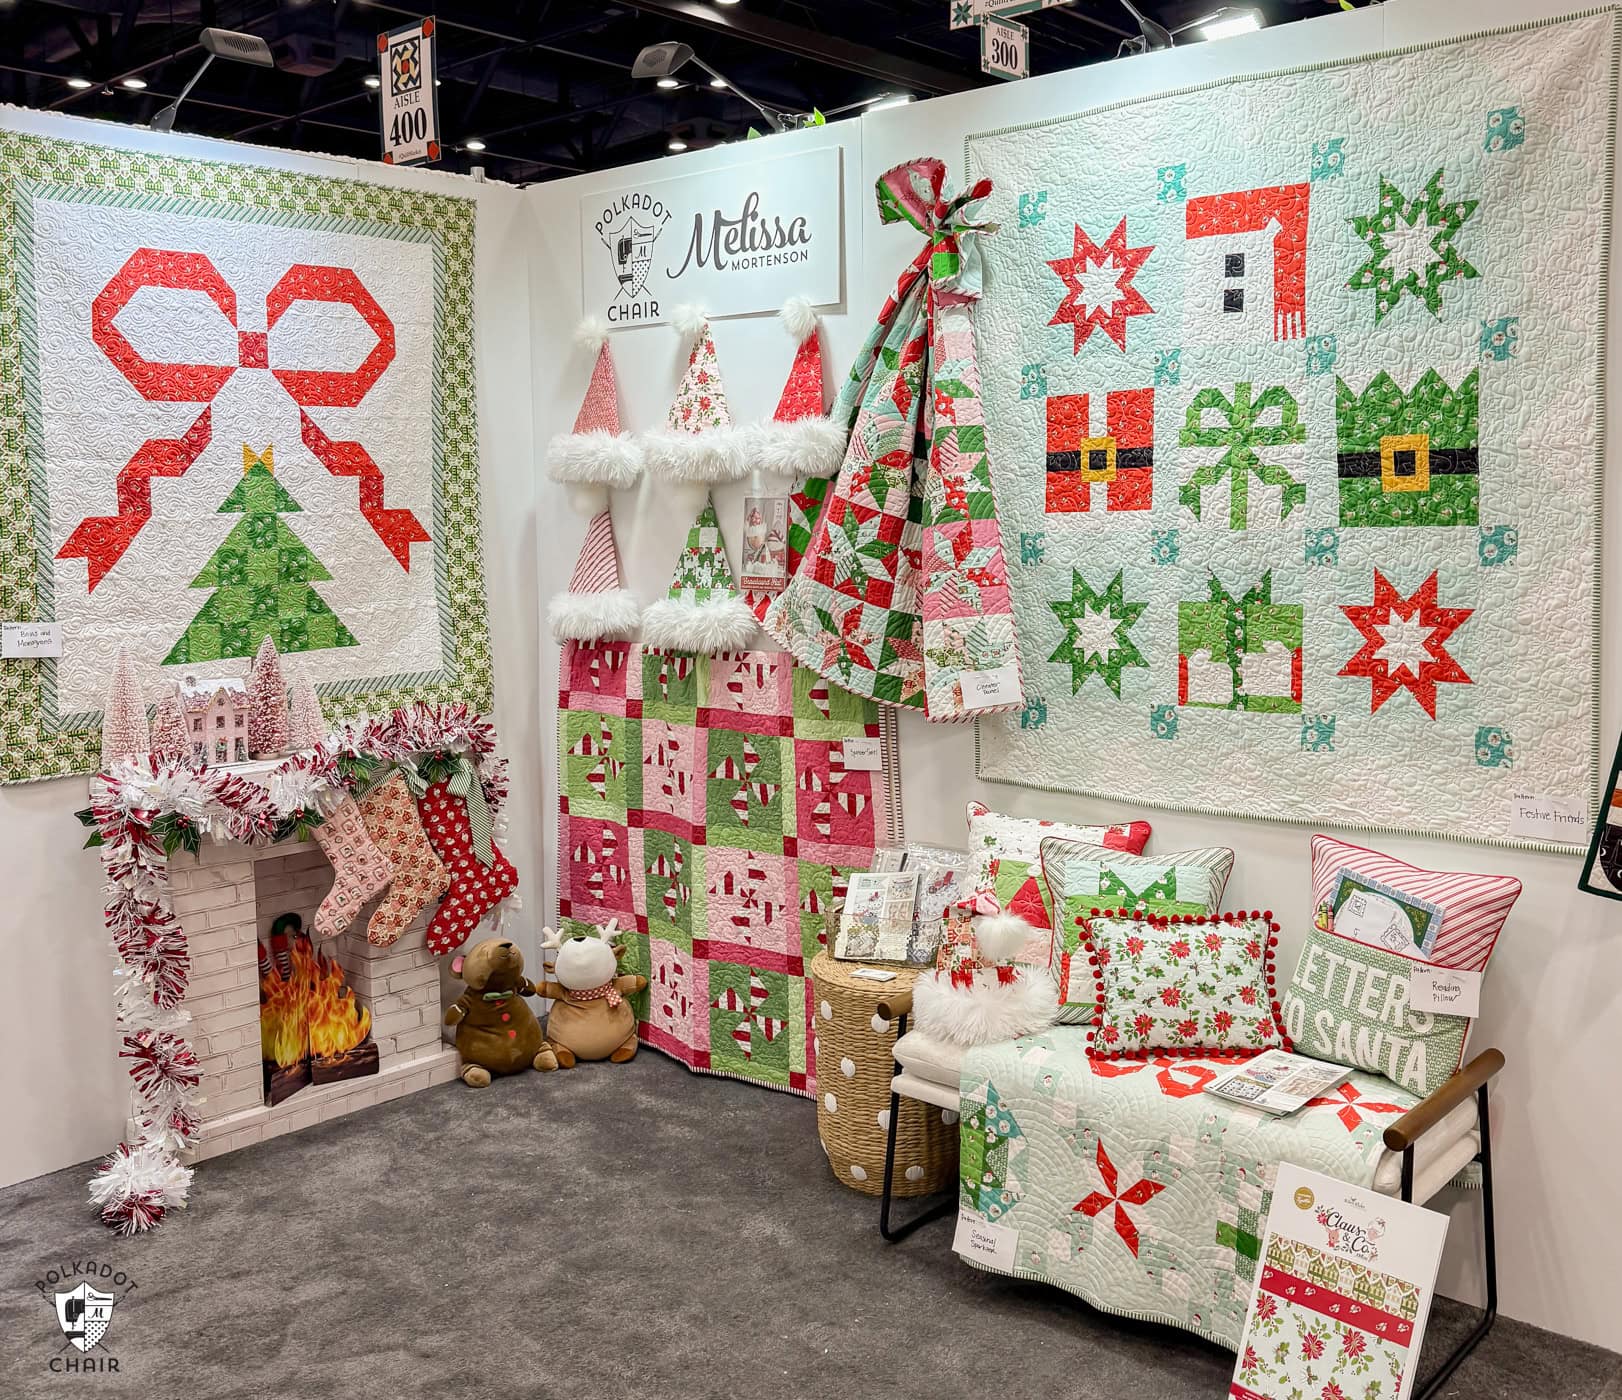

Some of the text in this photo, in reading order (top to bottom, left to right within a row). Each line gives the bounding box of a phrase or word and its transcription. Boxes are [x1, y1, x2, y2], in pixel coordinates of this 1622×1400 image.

[996, 26, 1015, 41] AISLE
[991, 38, 1018, 70] 300
[394, 91, 421, 110] AISLE
[390, 107, 427, 147] 400
[595, 193, 672, 235] POLKADOT
[666, 191, 812, 279] Melissa
[731, 249, 809, 272] MORTENSON
[607, 300, 660, 322] CHAIR
[1519, 807, 1585, 825] Festive Friends
[1293, 944, 1435, 1033] ETTER
[1432, 980, 1462, 996] Reading
[1432, 993, 1457, 1002] Pillow
[1313, 1009, 1428, 1093] SANTA
[1326, 1211, 1367, 1236] Claus
[1342, 1232, 1351, 1243] &
